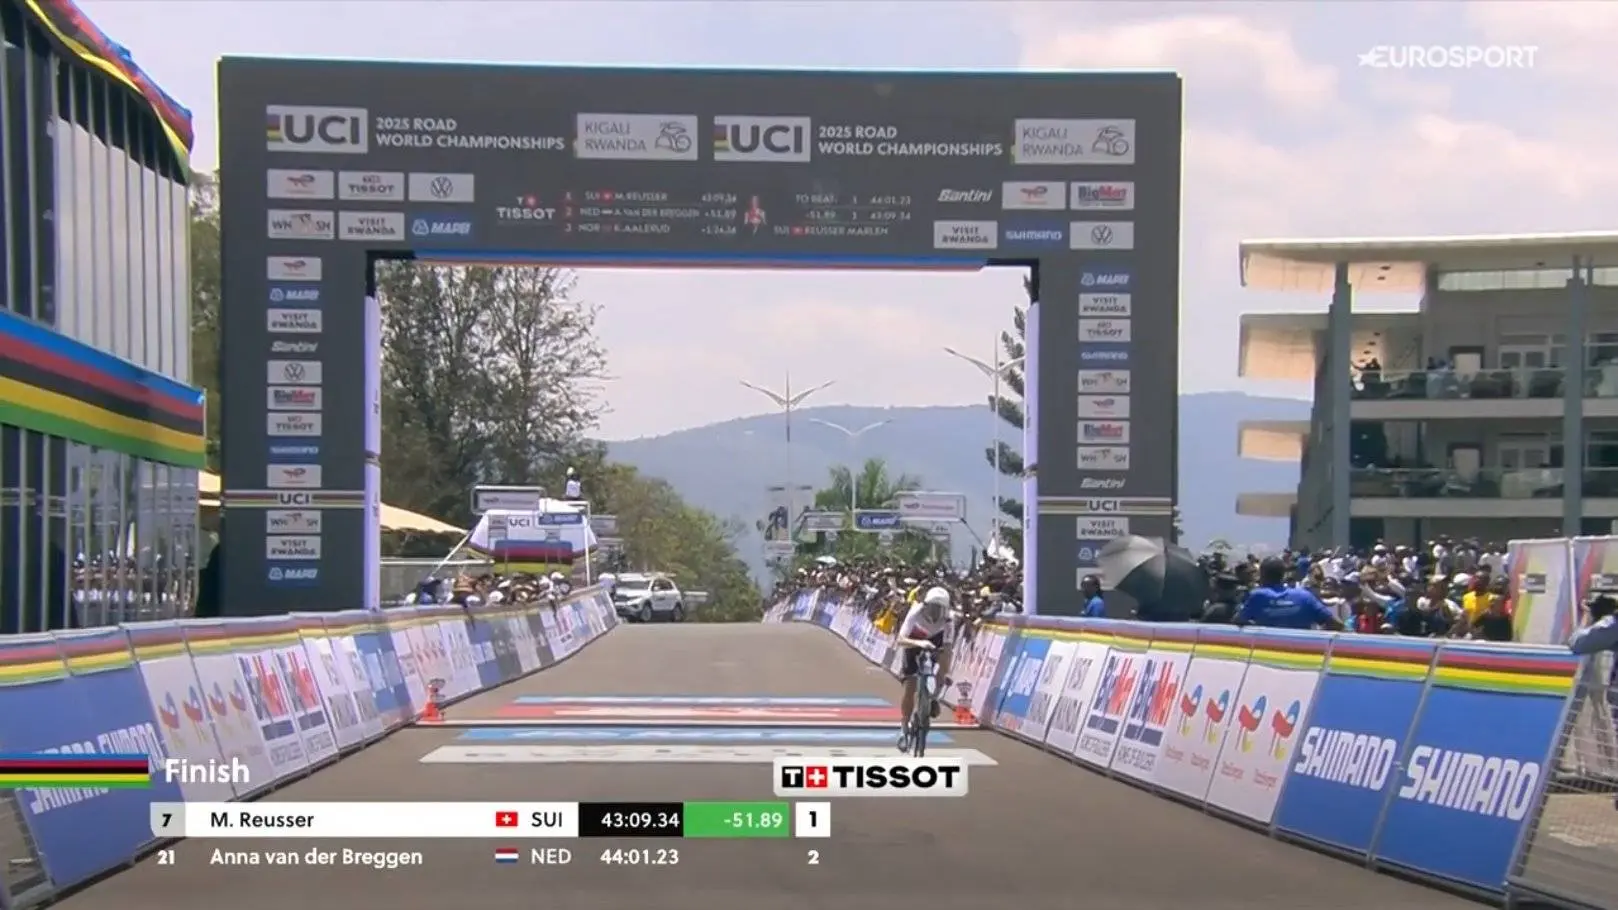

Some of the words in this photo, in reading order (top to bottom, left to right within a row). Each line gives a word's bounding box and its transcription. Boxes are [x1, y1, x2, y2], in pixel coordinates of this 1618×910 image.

[284, 114, 360, 145] UCI
[376, 117, 409, 131] 2025
[413, 118, 457, 132] ROAD
[585, 121, 631, 134] KIGALI
[730, 124, 803, 154] UCI
[819, 126, 852, 138] 2025
[855, 126, 898, 139] ROAD
[1022, 126, 1068, 139] KIGALI
[376, 133, 432, 147] WORLD
[436, 135, 565, 150] CHAMPIONSHIPS
[585, 139, 647, 152] RWANDA
[818, 142, 873, 154] WORLD
[876, 143, 1003, 156] CHAMPIONSHIPS
[1022, 143, 1084, 157] RWANDA
[348, 184, 395, 194] TISSOT
[937, 188, 993, 202] Santini
[1078, 185, 1128, 200] BigMat
[795, 194, 810, 203] TO
[495, 207, 556, 220] TISSOT
[358, 217, 386, 226] VISIT
[578, 223, 600, 232] NOR
[347, 226, 396, 236] RWANDA
[431, 222, 471, 235] MAPEI
[951, 226, 979, 234] VISIT
[1005, 229, 1063, 241] SHIMANO
[941, 234, 988, 244] RWANDA
[1092, 296, 1118, 304] VISIT
[281, 312, 308, 320] VISIT
[1080, 477, 1126, 489] Santini
[280, 493, 310, 506] UCI
[1088, 500, 1119, 512] UCI
[509, 517, 530, 528] UCI
[1090, 520, 1115, 528] VISIT
[280, 539, 308, 547] VISIT
[1294, 726, 1398, 792] SHIMANO
[1399, 744, 1540, 821] SHIMANO
